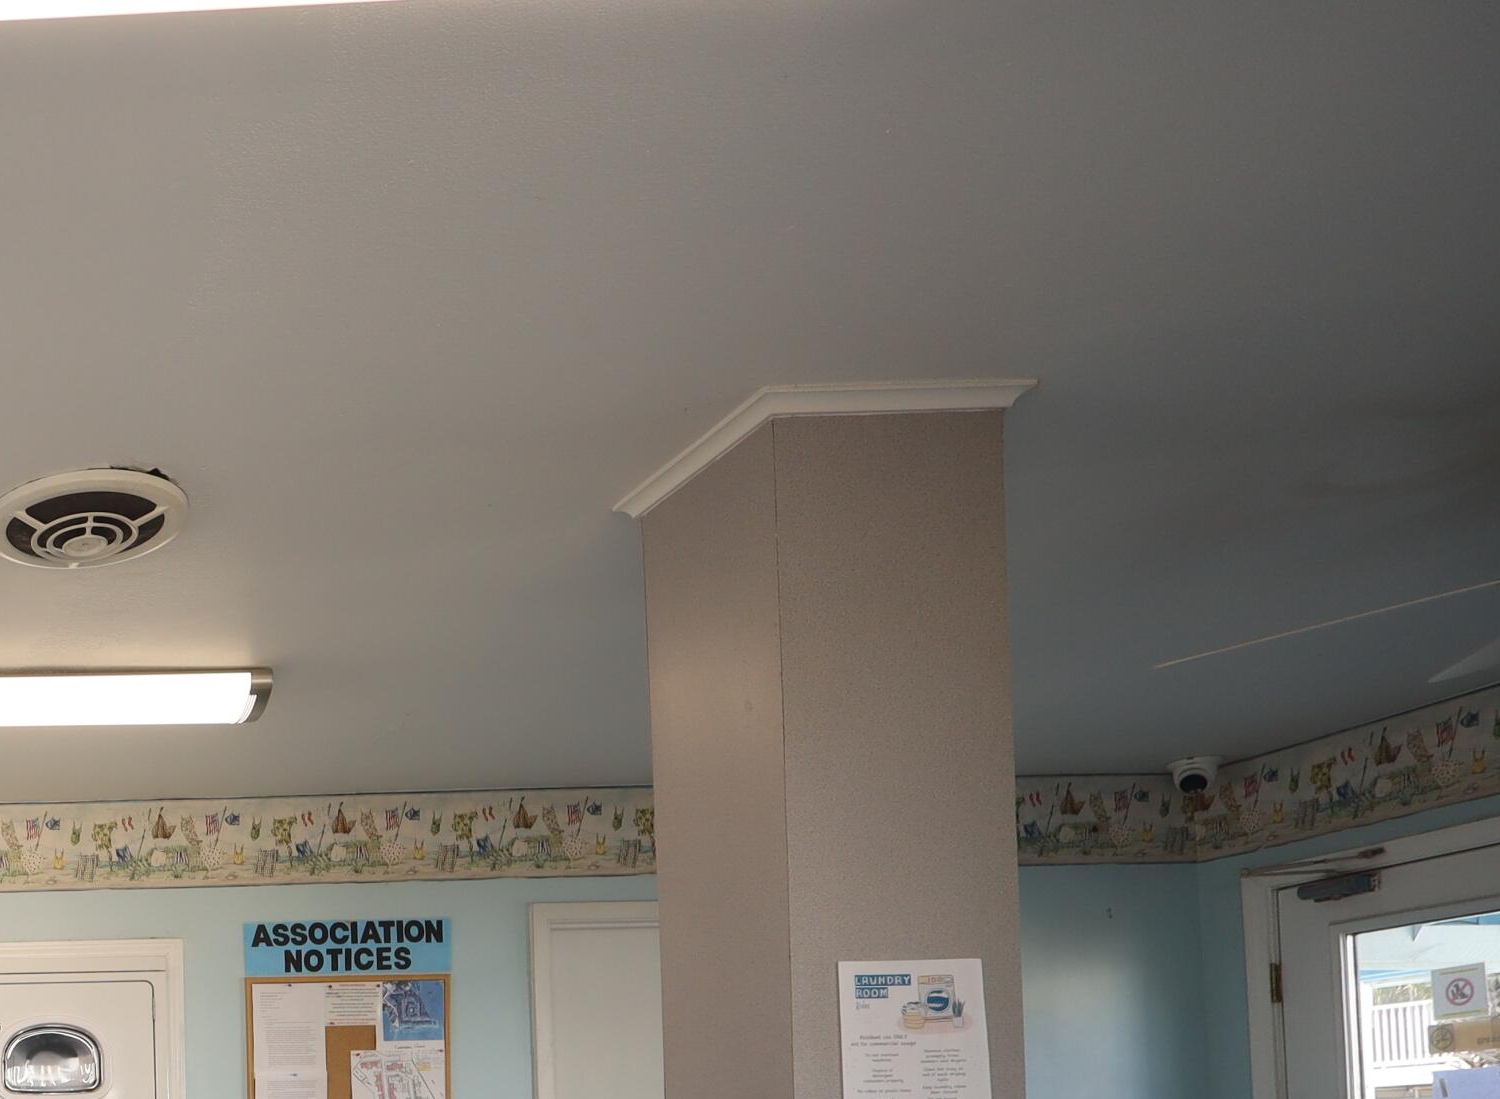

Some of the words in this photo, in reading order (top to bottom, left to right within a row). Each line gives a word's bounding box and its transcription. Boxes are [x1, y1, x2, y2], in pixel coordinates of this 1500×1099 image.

[252, 920, 443, 947] ASSOCIATION
[285, 947, 412, 972] NOTICES
[855, 975, 910, 985] LAUNDRY
[856, 988, 888, 998] ROOM
